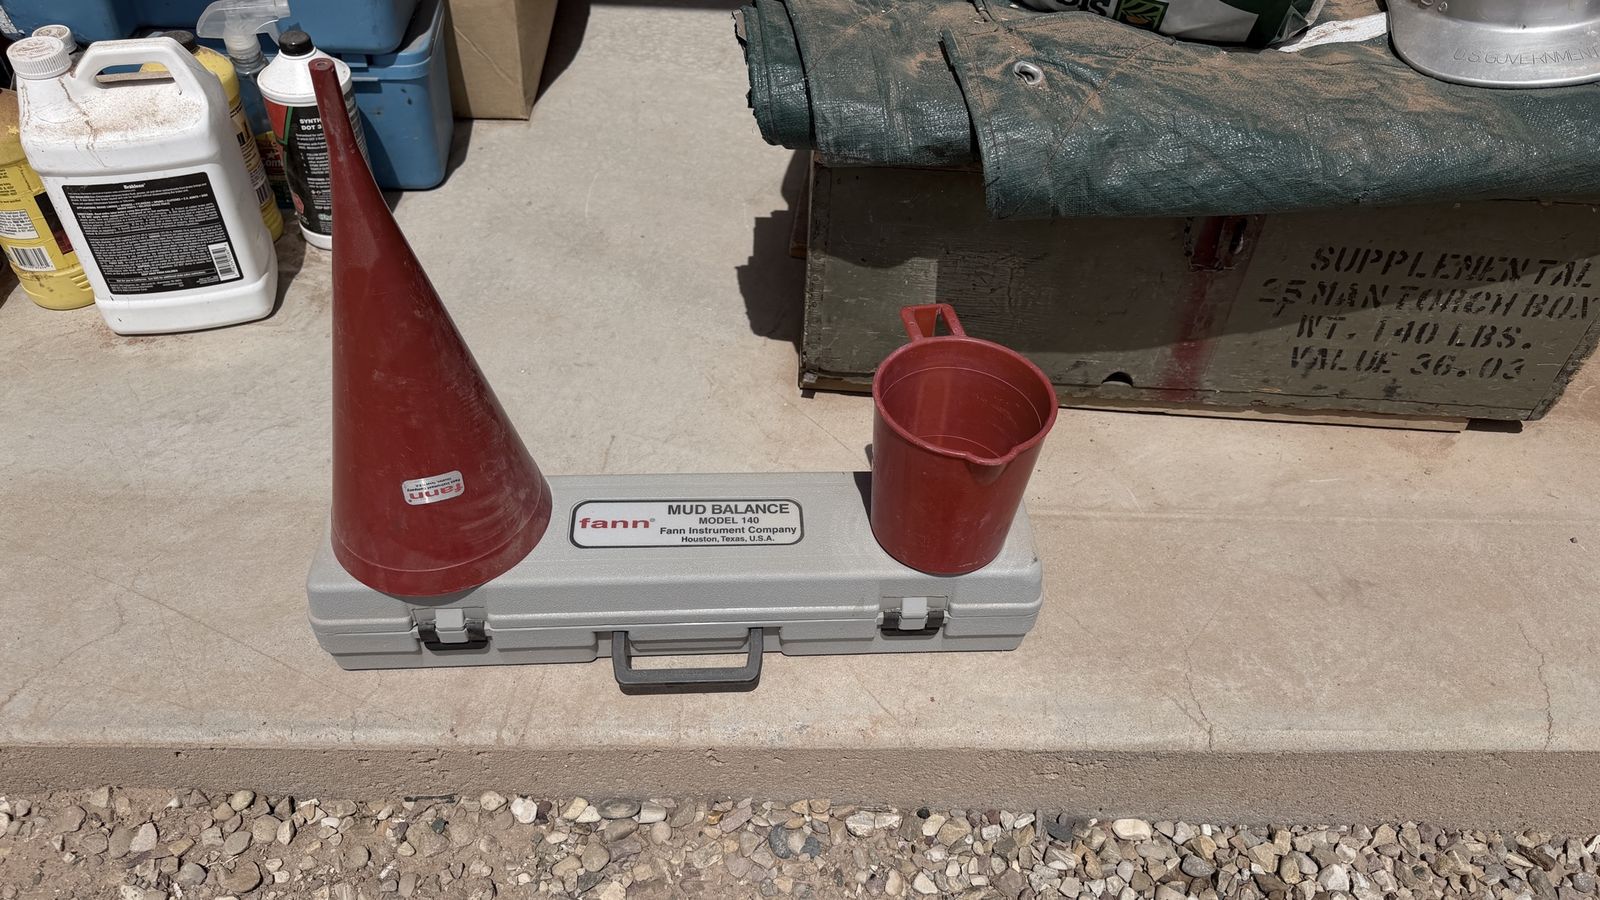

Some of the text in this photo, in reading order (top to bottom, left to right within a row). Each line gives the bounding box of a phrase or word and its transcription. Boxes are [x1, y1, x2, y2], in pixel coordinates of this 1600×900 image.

[1484, 47, 1600, 65] GOVERNMENT
[1310, 246, 1592, 288] SUPPLEMENTAL
[1311, 281, 1389, 308] MAN
[1396, 285, 1518, 317] TORCH
[1296, 314, 1532, 350] WT. 140 LBS.
[1290, 346, 1525, 380] VALUE 36.03
[409, 483, 463, 499] fann
[667, 503, 790, 515] MUD BALANCE
[698, 516, 760, 525] MODEL 140
[660, 525, 797, 535] Fann Instrument Company
